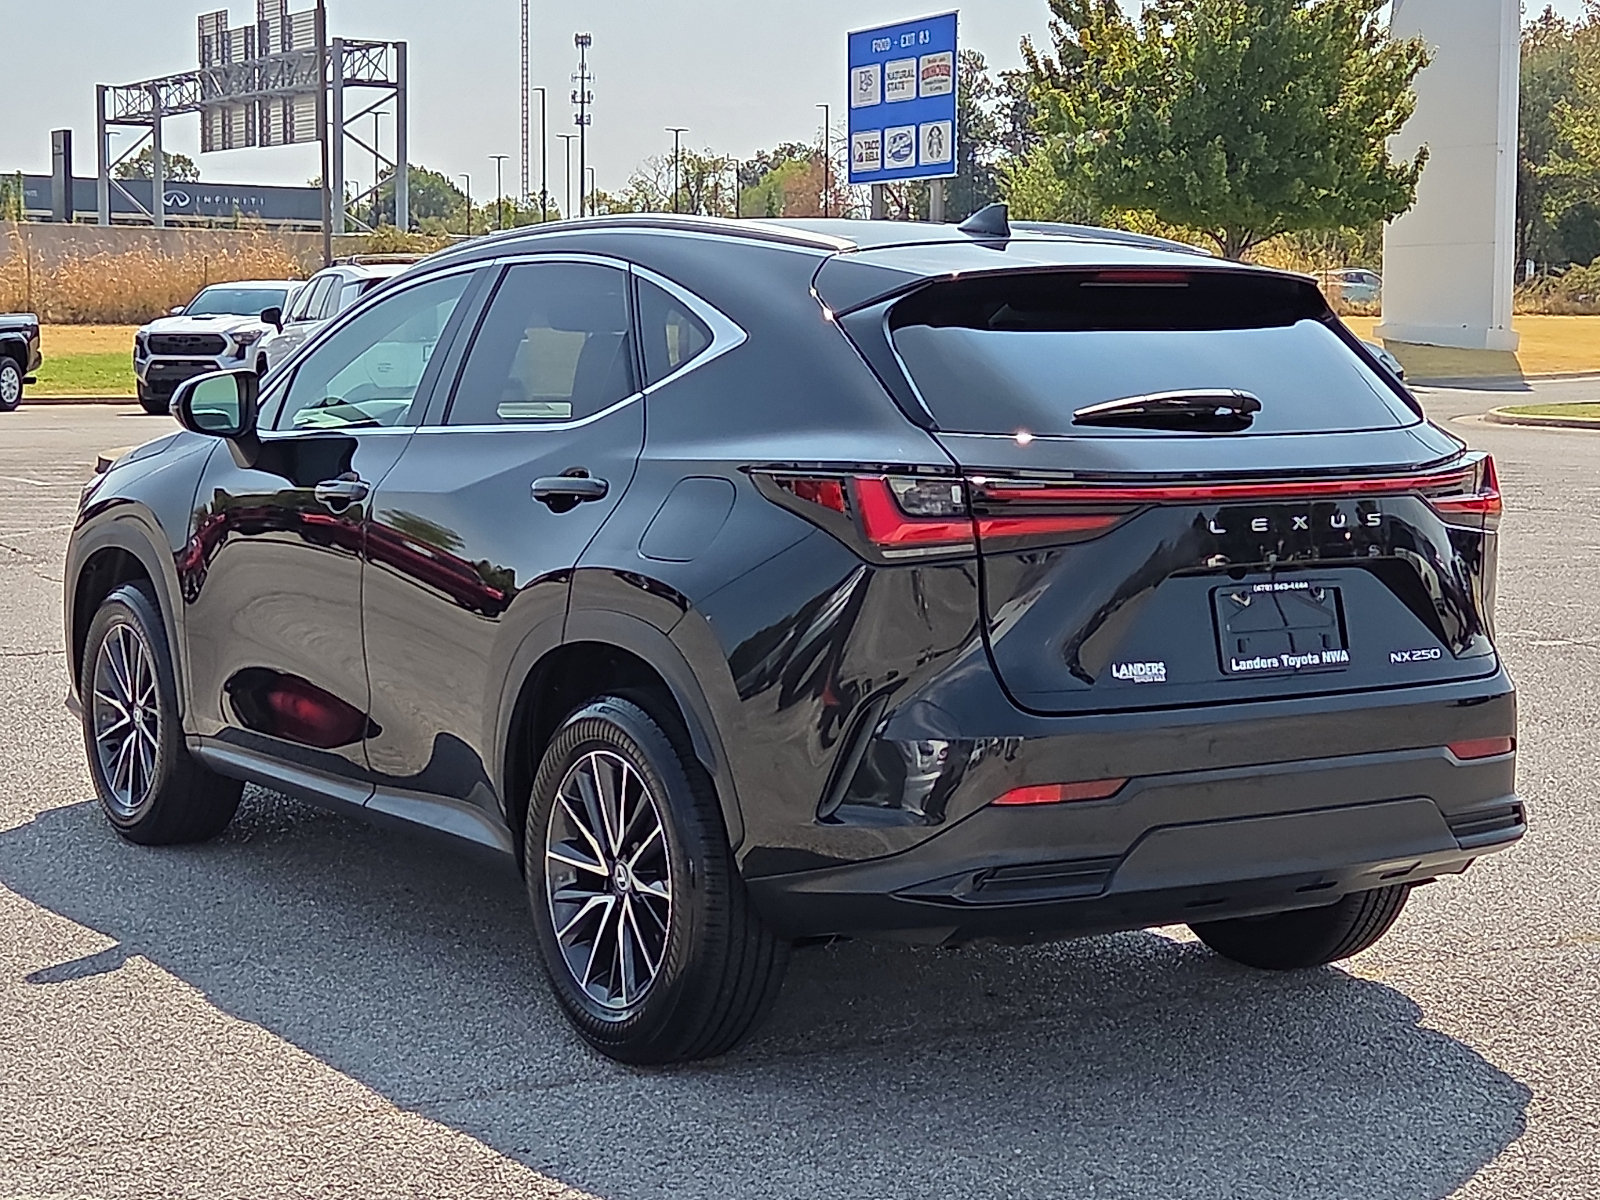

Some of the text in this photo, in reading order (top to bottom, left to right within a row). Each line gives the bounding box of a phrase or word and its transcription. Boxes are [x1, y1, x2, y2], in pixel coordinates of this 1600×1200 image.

[872, 37, 891, 53] FOOD
[900, 32, 916, 48] EXIT
[887, 68, 915, 81] NATURAL
[887, 81, 905, 92] STATE
[864, 139, 880, 150] TACO
[865, 151, 880, 162] BELL
[195, 194, 265, 206] INFINITI
[1209, 512, 1382, 534] LEXUS
[1231, 649, 1350, 671] Landers Toyota NWA
[1390, 648, 1441, 664] NX250
[1111, 661, 1167, 678] LANDERS
